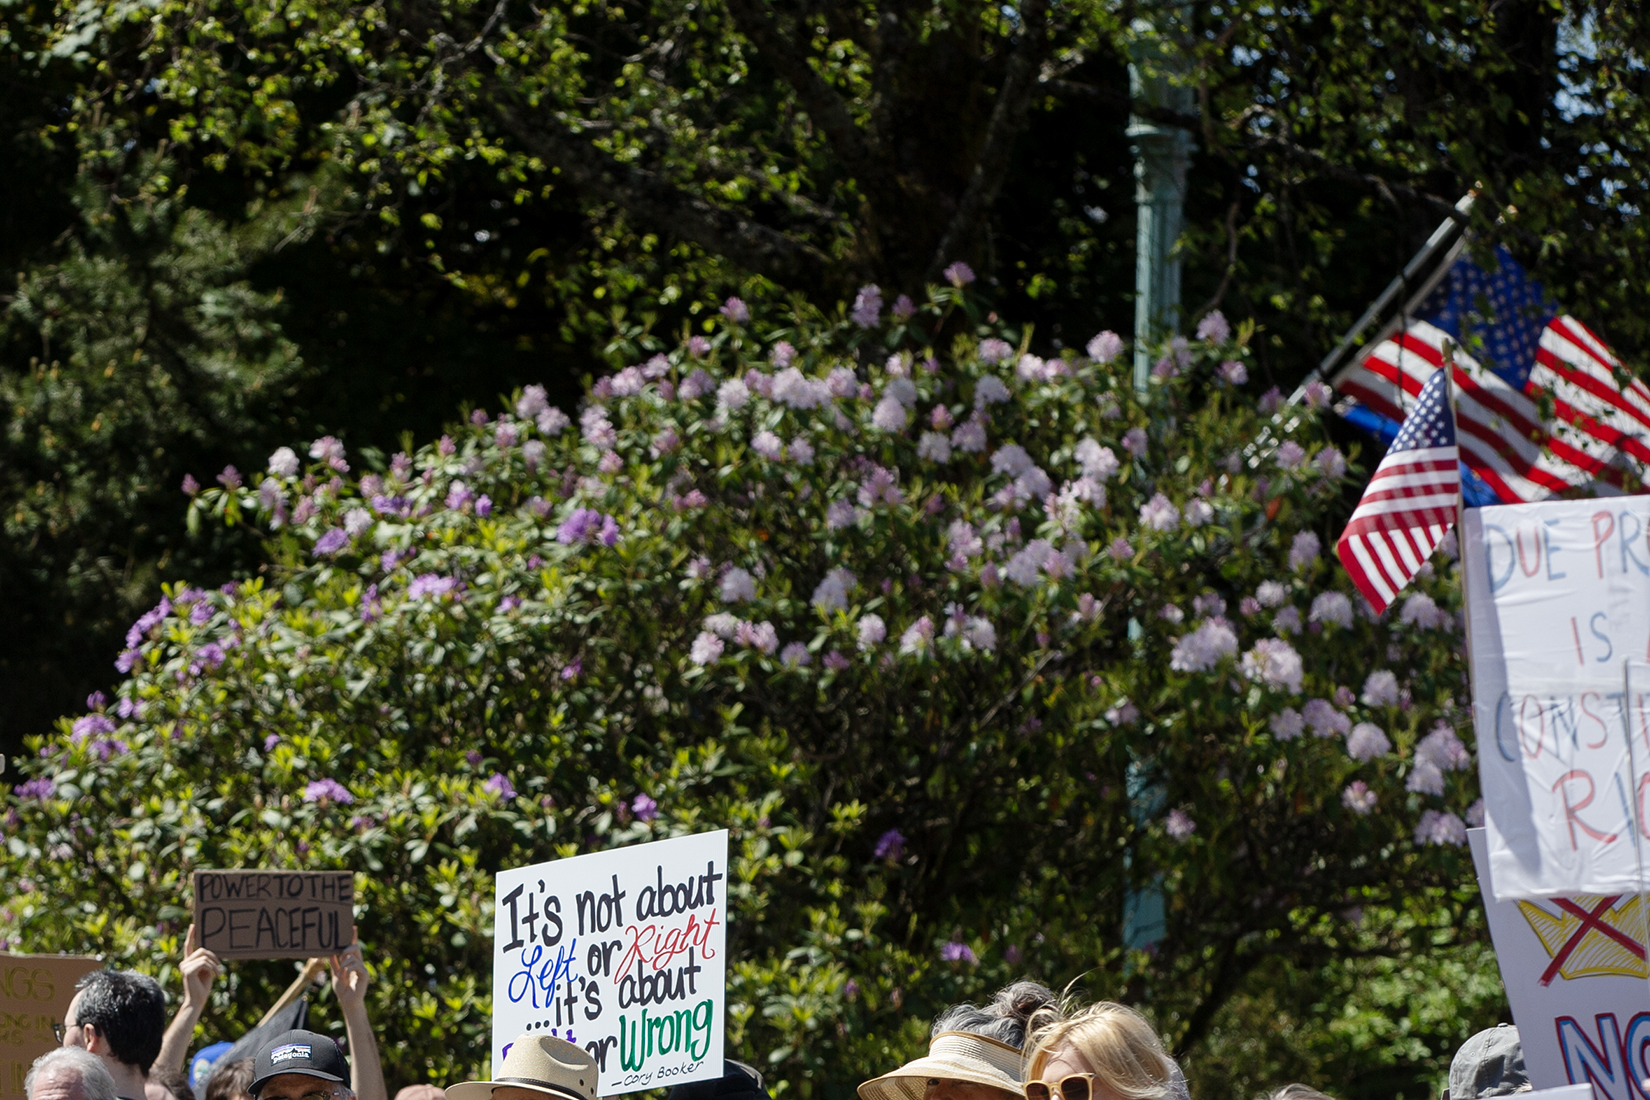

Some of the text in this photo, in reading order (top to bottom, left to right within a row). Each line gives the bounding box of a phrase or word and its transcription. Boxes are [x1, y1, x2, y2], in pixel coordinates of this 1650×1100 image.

[1484, 510, 1650, 594] DUE PR
[1570, 611, 1613, 666] IS
[200, 873, 352, 901] POWER TO THE
[502, 861, 723, 953] It's not about
[201, 907, 349, 950] PEACEFUL
[508, 908, 720, 1008] Left or Right
[619, 947, 701, 1009] about
[619, 999, 714, 1072] Wrong
[657, 1060, 704, 1079] Booker
